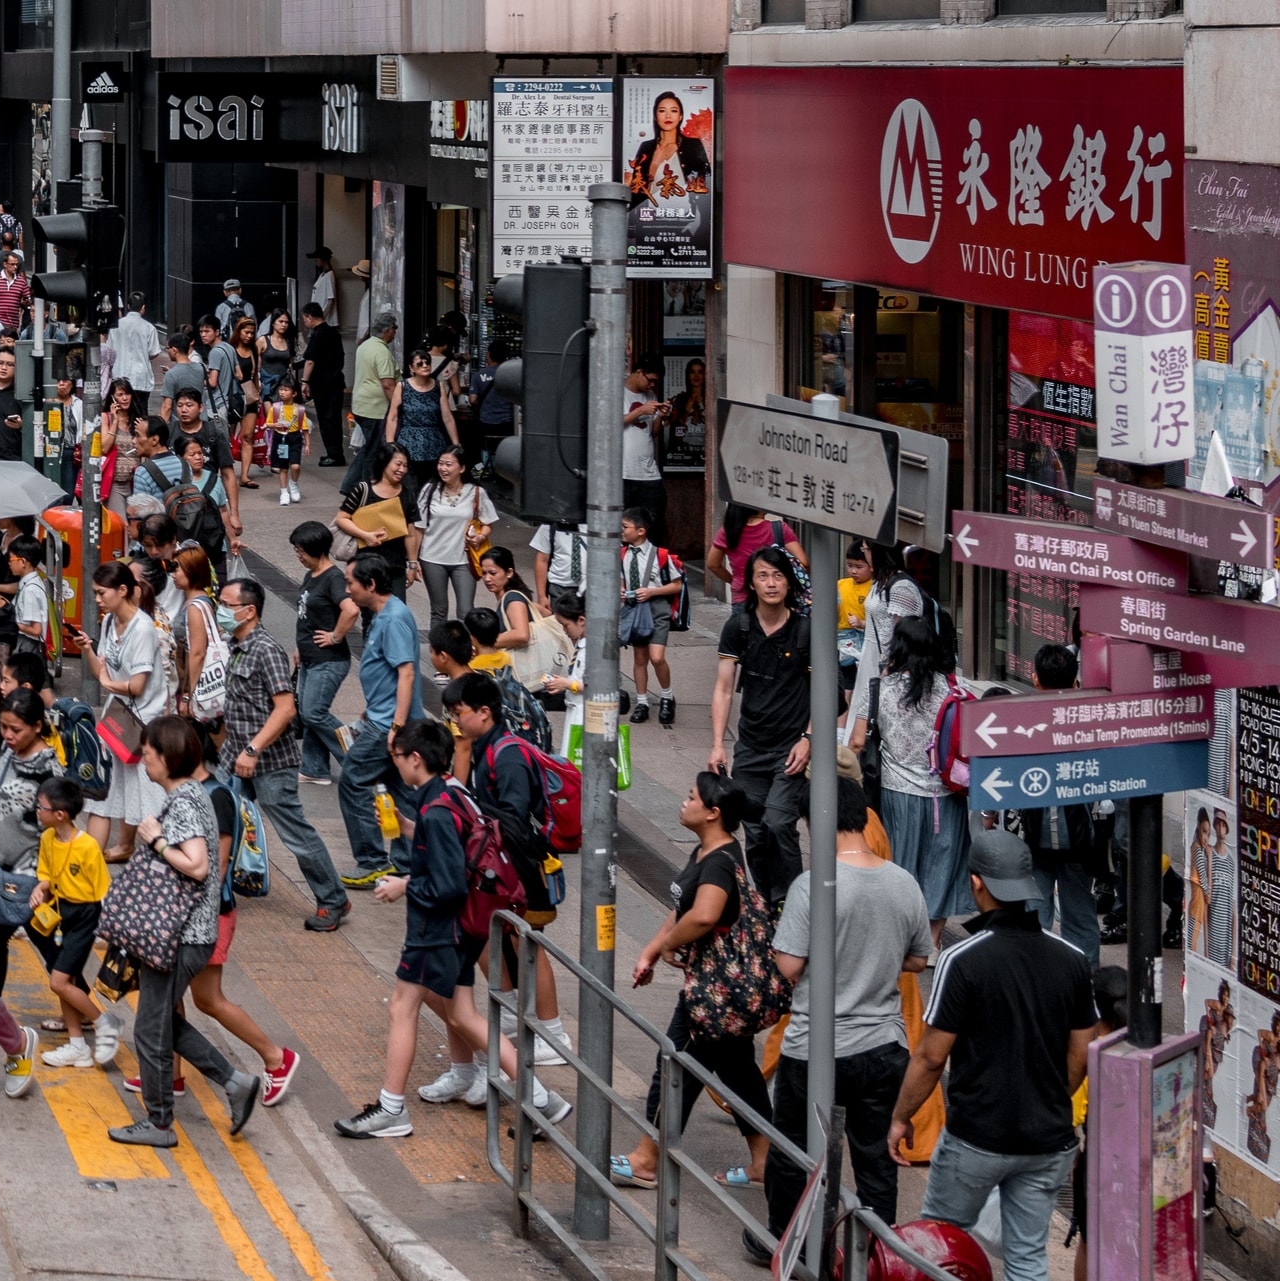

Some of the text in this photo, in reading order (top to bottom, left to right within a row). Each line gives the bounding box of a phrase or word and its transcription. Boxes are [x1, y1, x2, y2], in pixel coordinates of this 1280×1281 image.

[87, 84, 119, 94] adidas
[524, 83, 601, 91] 2294-0222 9A
[167, 94, 265, 140] isai
[956, 118, 1172, 241] 永隆銀行
[521, 222, 556, 230] JOSEPH
[959, 243, 1088, 289] WING LUNG
[1108, 344, 1129, 447] Wan Chai
[1151, 345, 1190, 450] 灣仔
[759, 423, 848, 464] Johnston Road
[768, 467, 836, 514] 莊士敦道
[1117, 488, 1167, 519] 太原街市集
[1117, 512, 1208, 549] Tai Yuen Street Market
[1014, 533, 1109, 562] 舊灣仔郵政局
[1015, 554, 1176, 588] Old Wan Chai Post Office
[1120, 596, 1167, 621] 春園街
[1120, 619, 1245, 653] Spring Garden Lane
[1153, 652, 1183, 671] 藍屋
[1153, 672, 1212, 689] Blue House
[1052, 720, 1209, 746] Wan Chai Temp Promenade (15mins)
[1056, 759, 1099, 781] 灣仔站
[1056, 777, 1147, 799] Wan Chai Station
